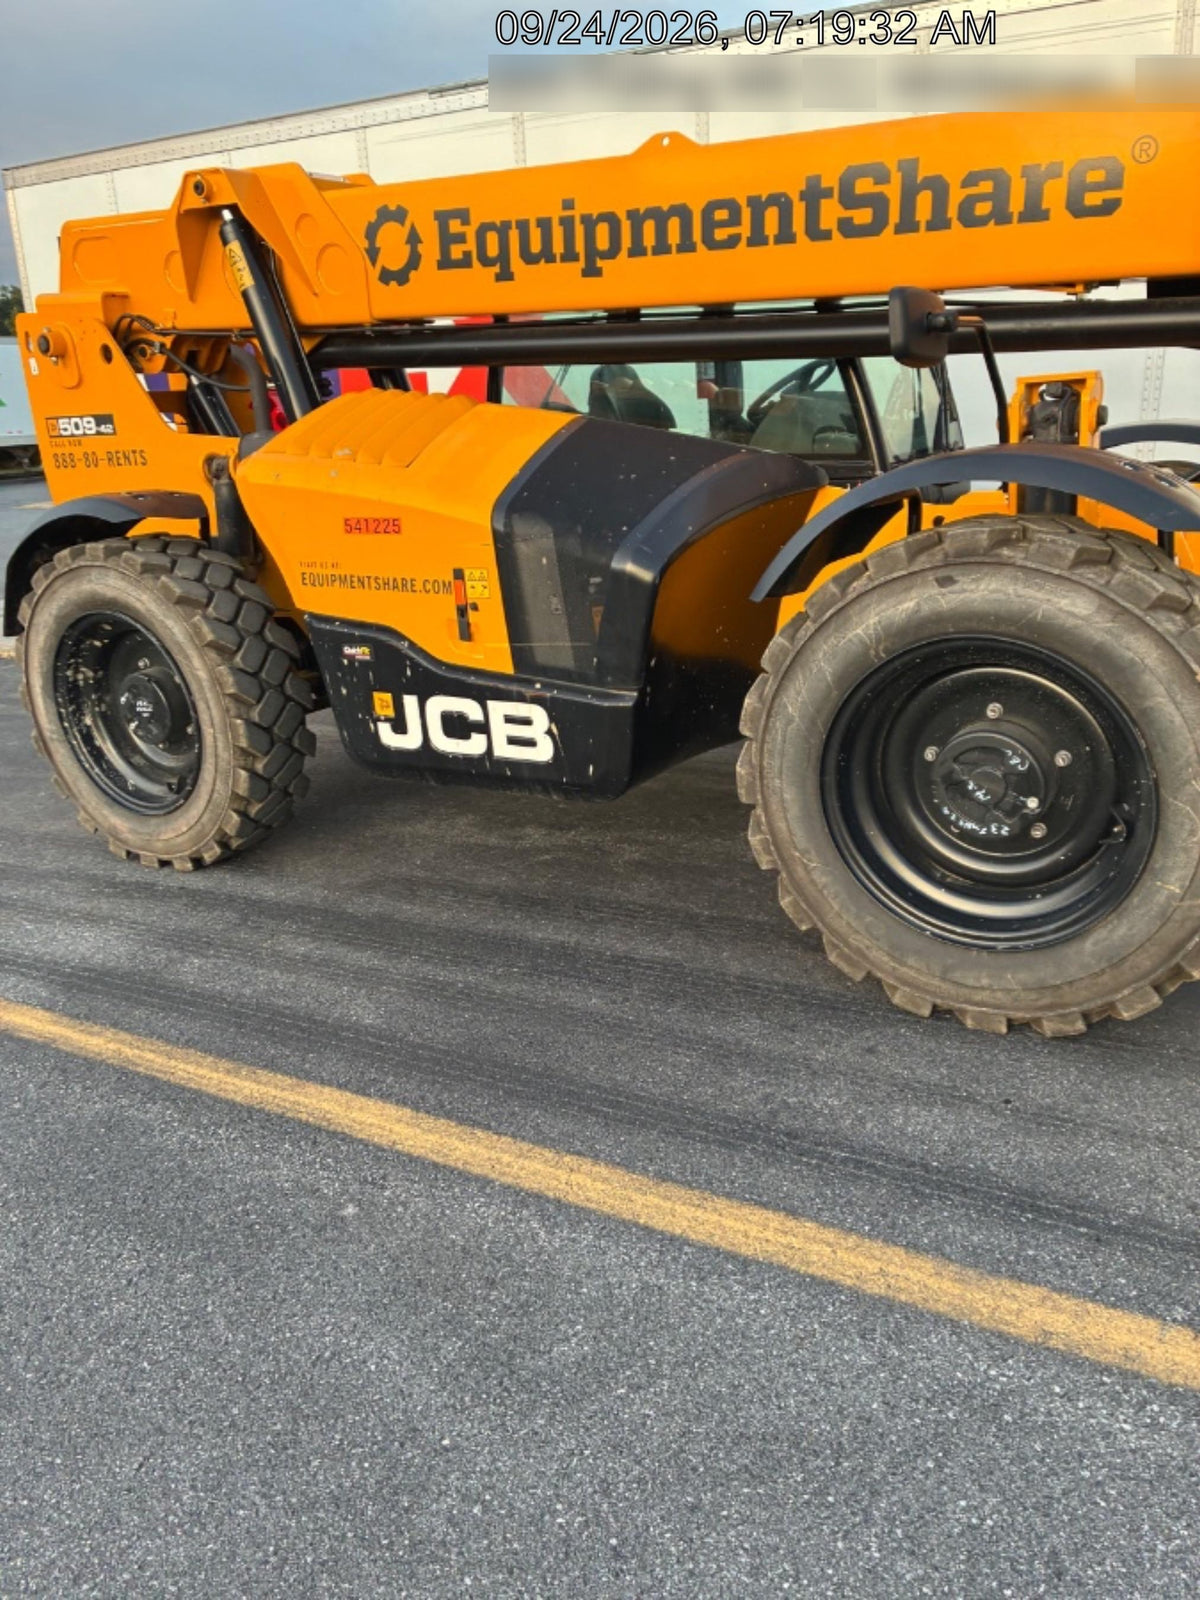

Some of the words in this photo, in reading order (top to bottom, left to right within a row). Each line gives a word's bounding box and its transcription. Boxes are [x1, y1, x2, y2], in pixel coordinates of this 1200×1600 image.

[433, 154, 1126, 282] EquipmentShare
[53, 450, 148, 469] 888-80-RENTS
[344, 518, 401, 535] 541225
[301, 571, 453, 595] EQUIPMENTSHARE.COM
[377, 694, 554, 764] JCB
